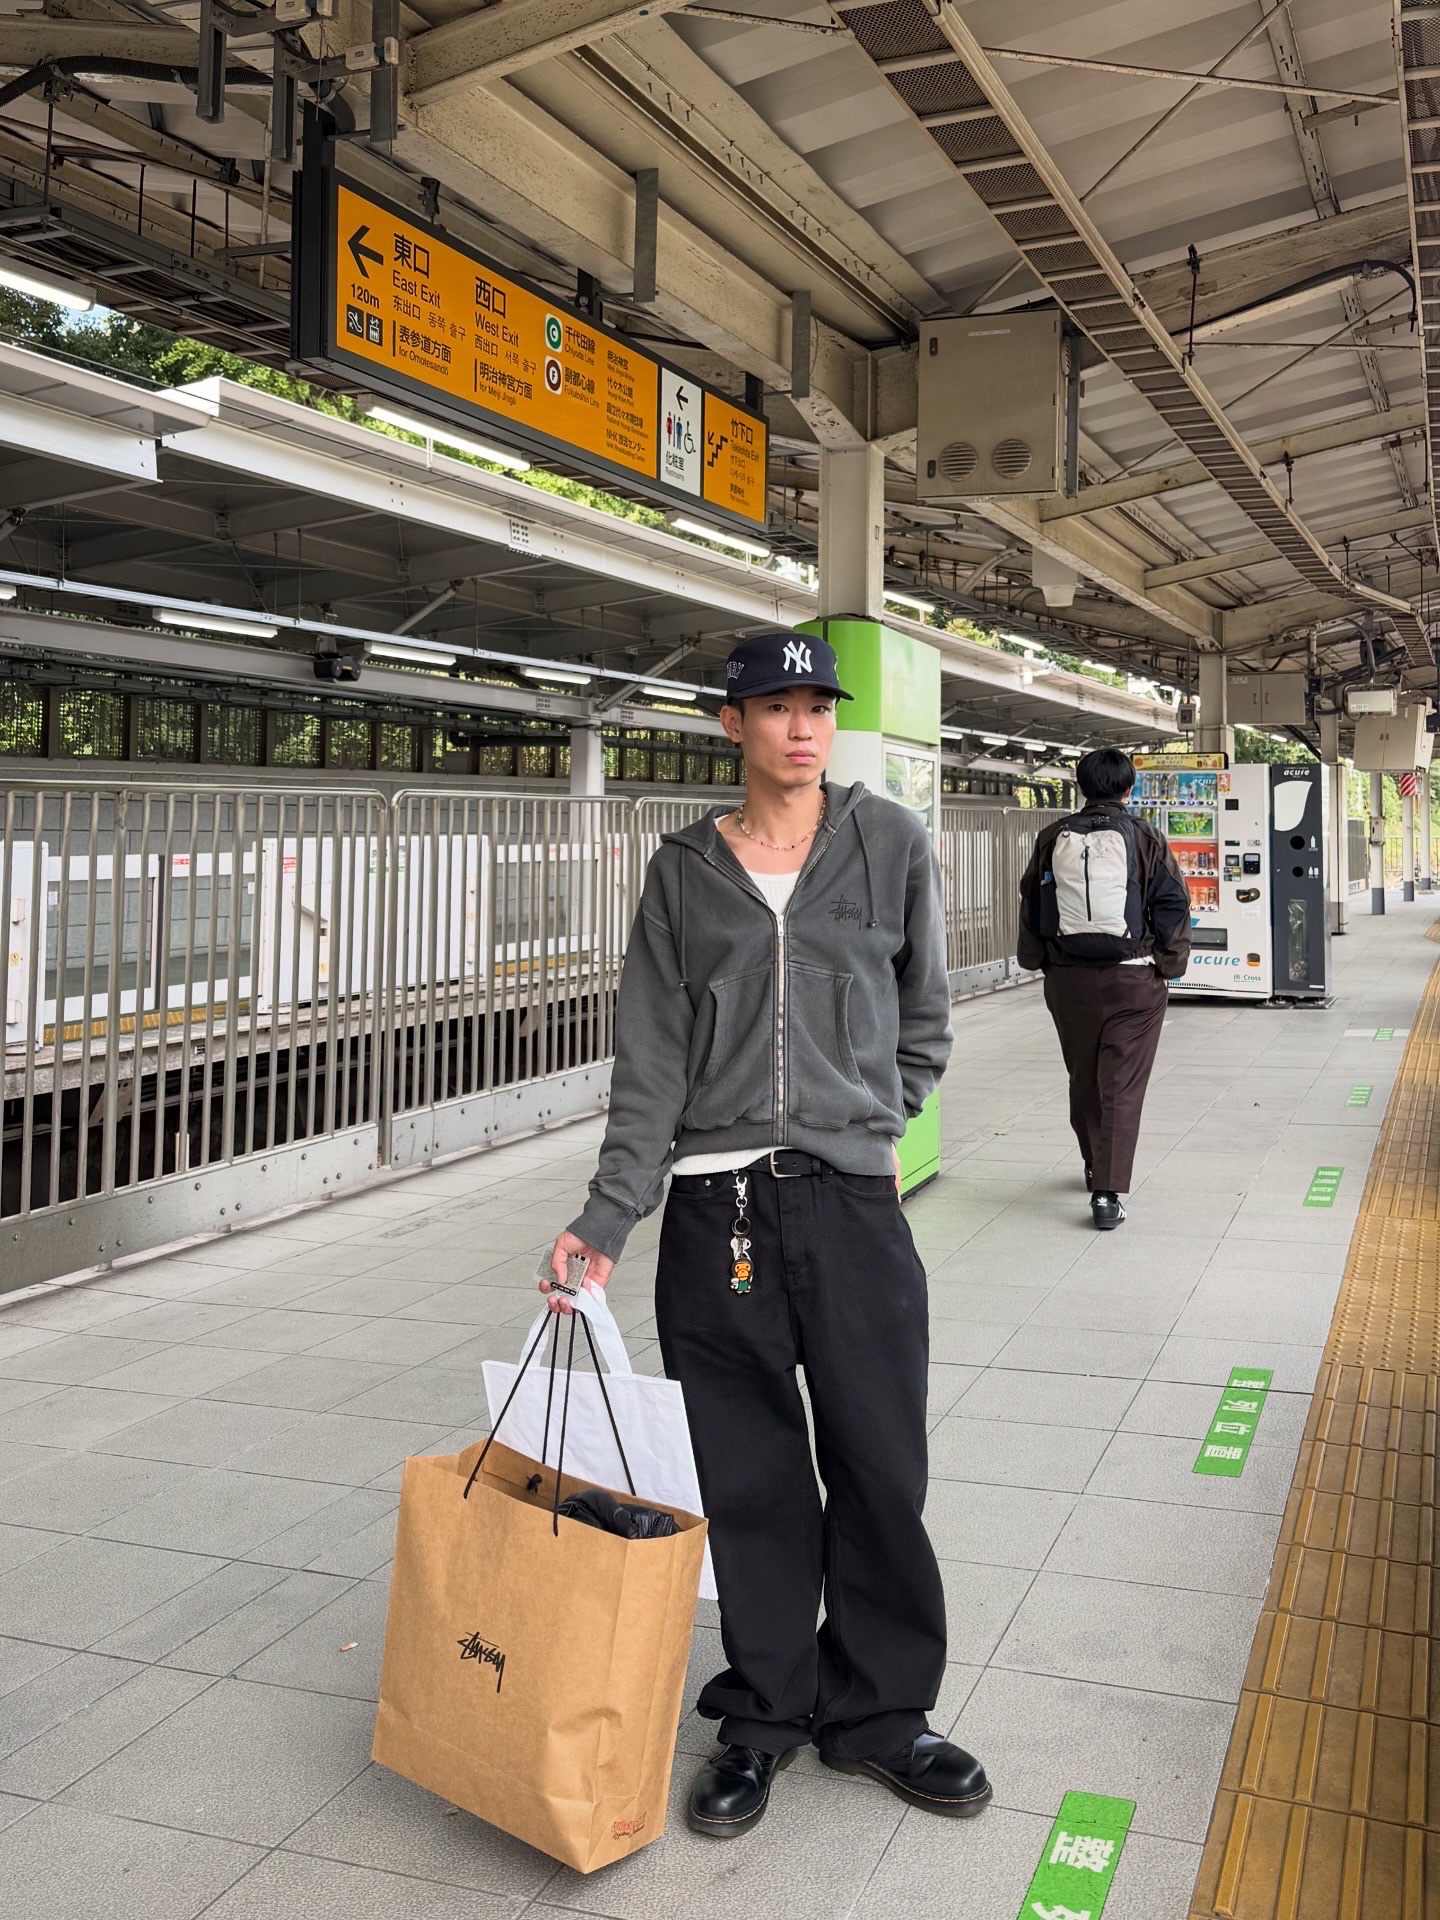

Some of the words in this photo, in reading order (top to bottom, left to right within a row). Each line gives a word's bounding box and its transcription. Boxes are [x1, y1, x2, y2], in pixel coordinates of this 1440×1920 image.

[394, 233, 430, 279] 東口
[351, 283, 380, 309] 120m
[392, 270, 418, 297] East
[421, 284, 440, 308] Exit
[475, 276, 506, 319] 西口
[393, 294, 420, 320] 东出口
[475, 311, 500, 338] West
[502, 326, 519, 348] Exit
[566, 326, 596, 354] 千代田線
[399, 346, 408, 358] for
[400, 325, 452, 364] 表参道方面
[475, 334, 498, 358] 西出口
[584, 355, 594, 366] Line
[480, 361, 532, 400] 明治神宮方面
[488, 384, 500, 401] Meiji
[565, 366, 595, 394] 副都心線
[590, 396, 600, 408] Line
[731, 418, 753, 444] 竹下口
[782, 640, 812, 674] NY
[1194, 954, 1240, 966] acure
